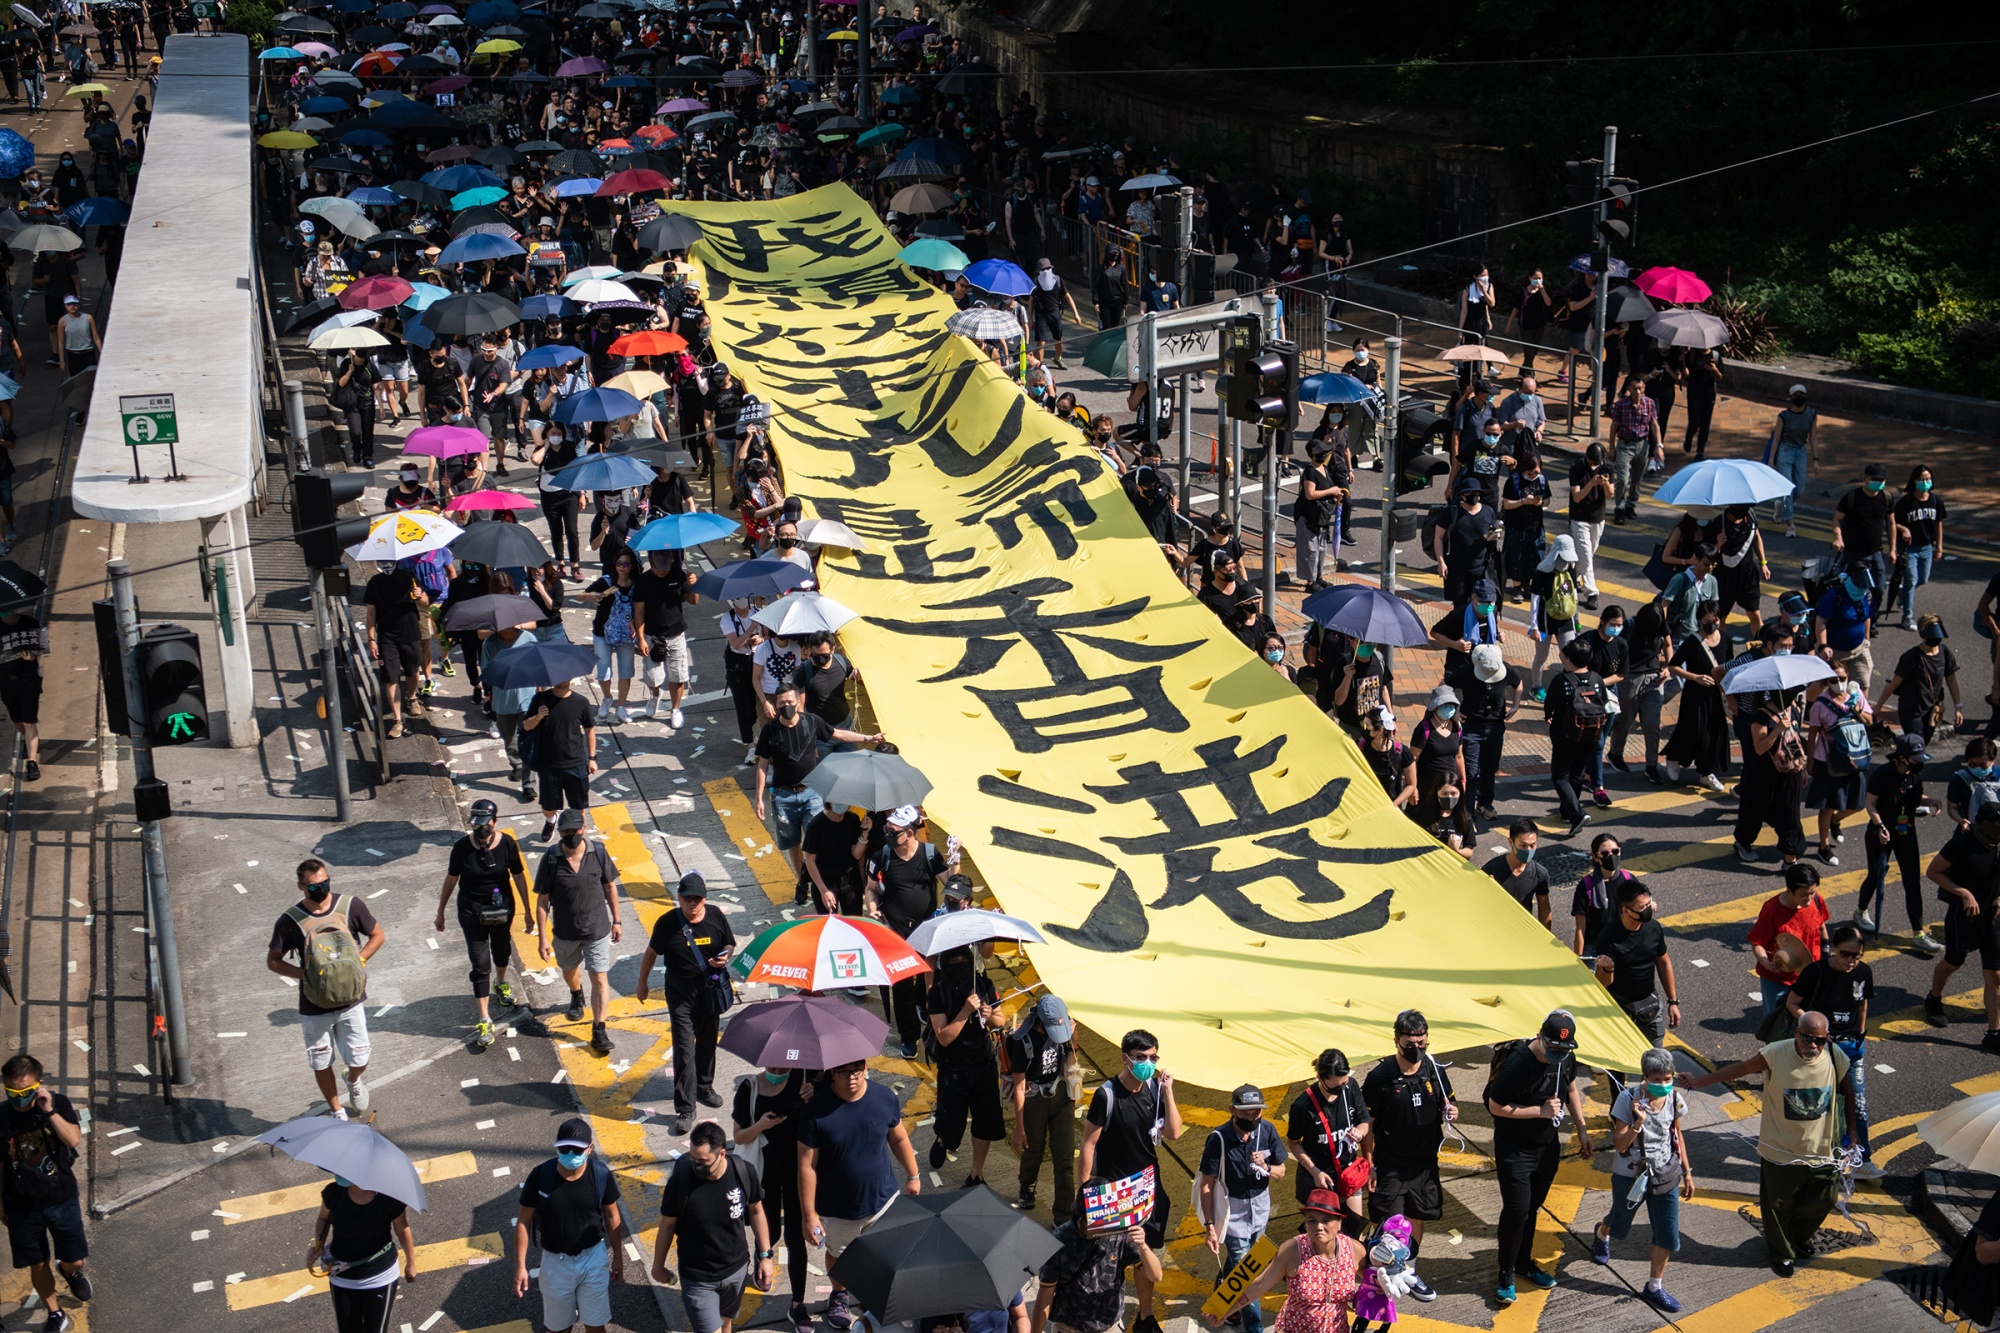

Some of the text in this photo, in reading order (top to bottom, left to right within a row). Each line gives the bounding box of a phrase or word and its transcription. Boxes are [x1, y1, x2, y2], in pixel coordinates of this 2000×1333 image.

[697, 210, 1440, 952] 我願榮光歸香港
[1317, 1130, 1337, 1144] JUT
[1089, 1206, 1117, 1220] THANK
[1117, 1200, 1133, 1212] YOU
[1217, 1253, 1262, 1305] LOVE
